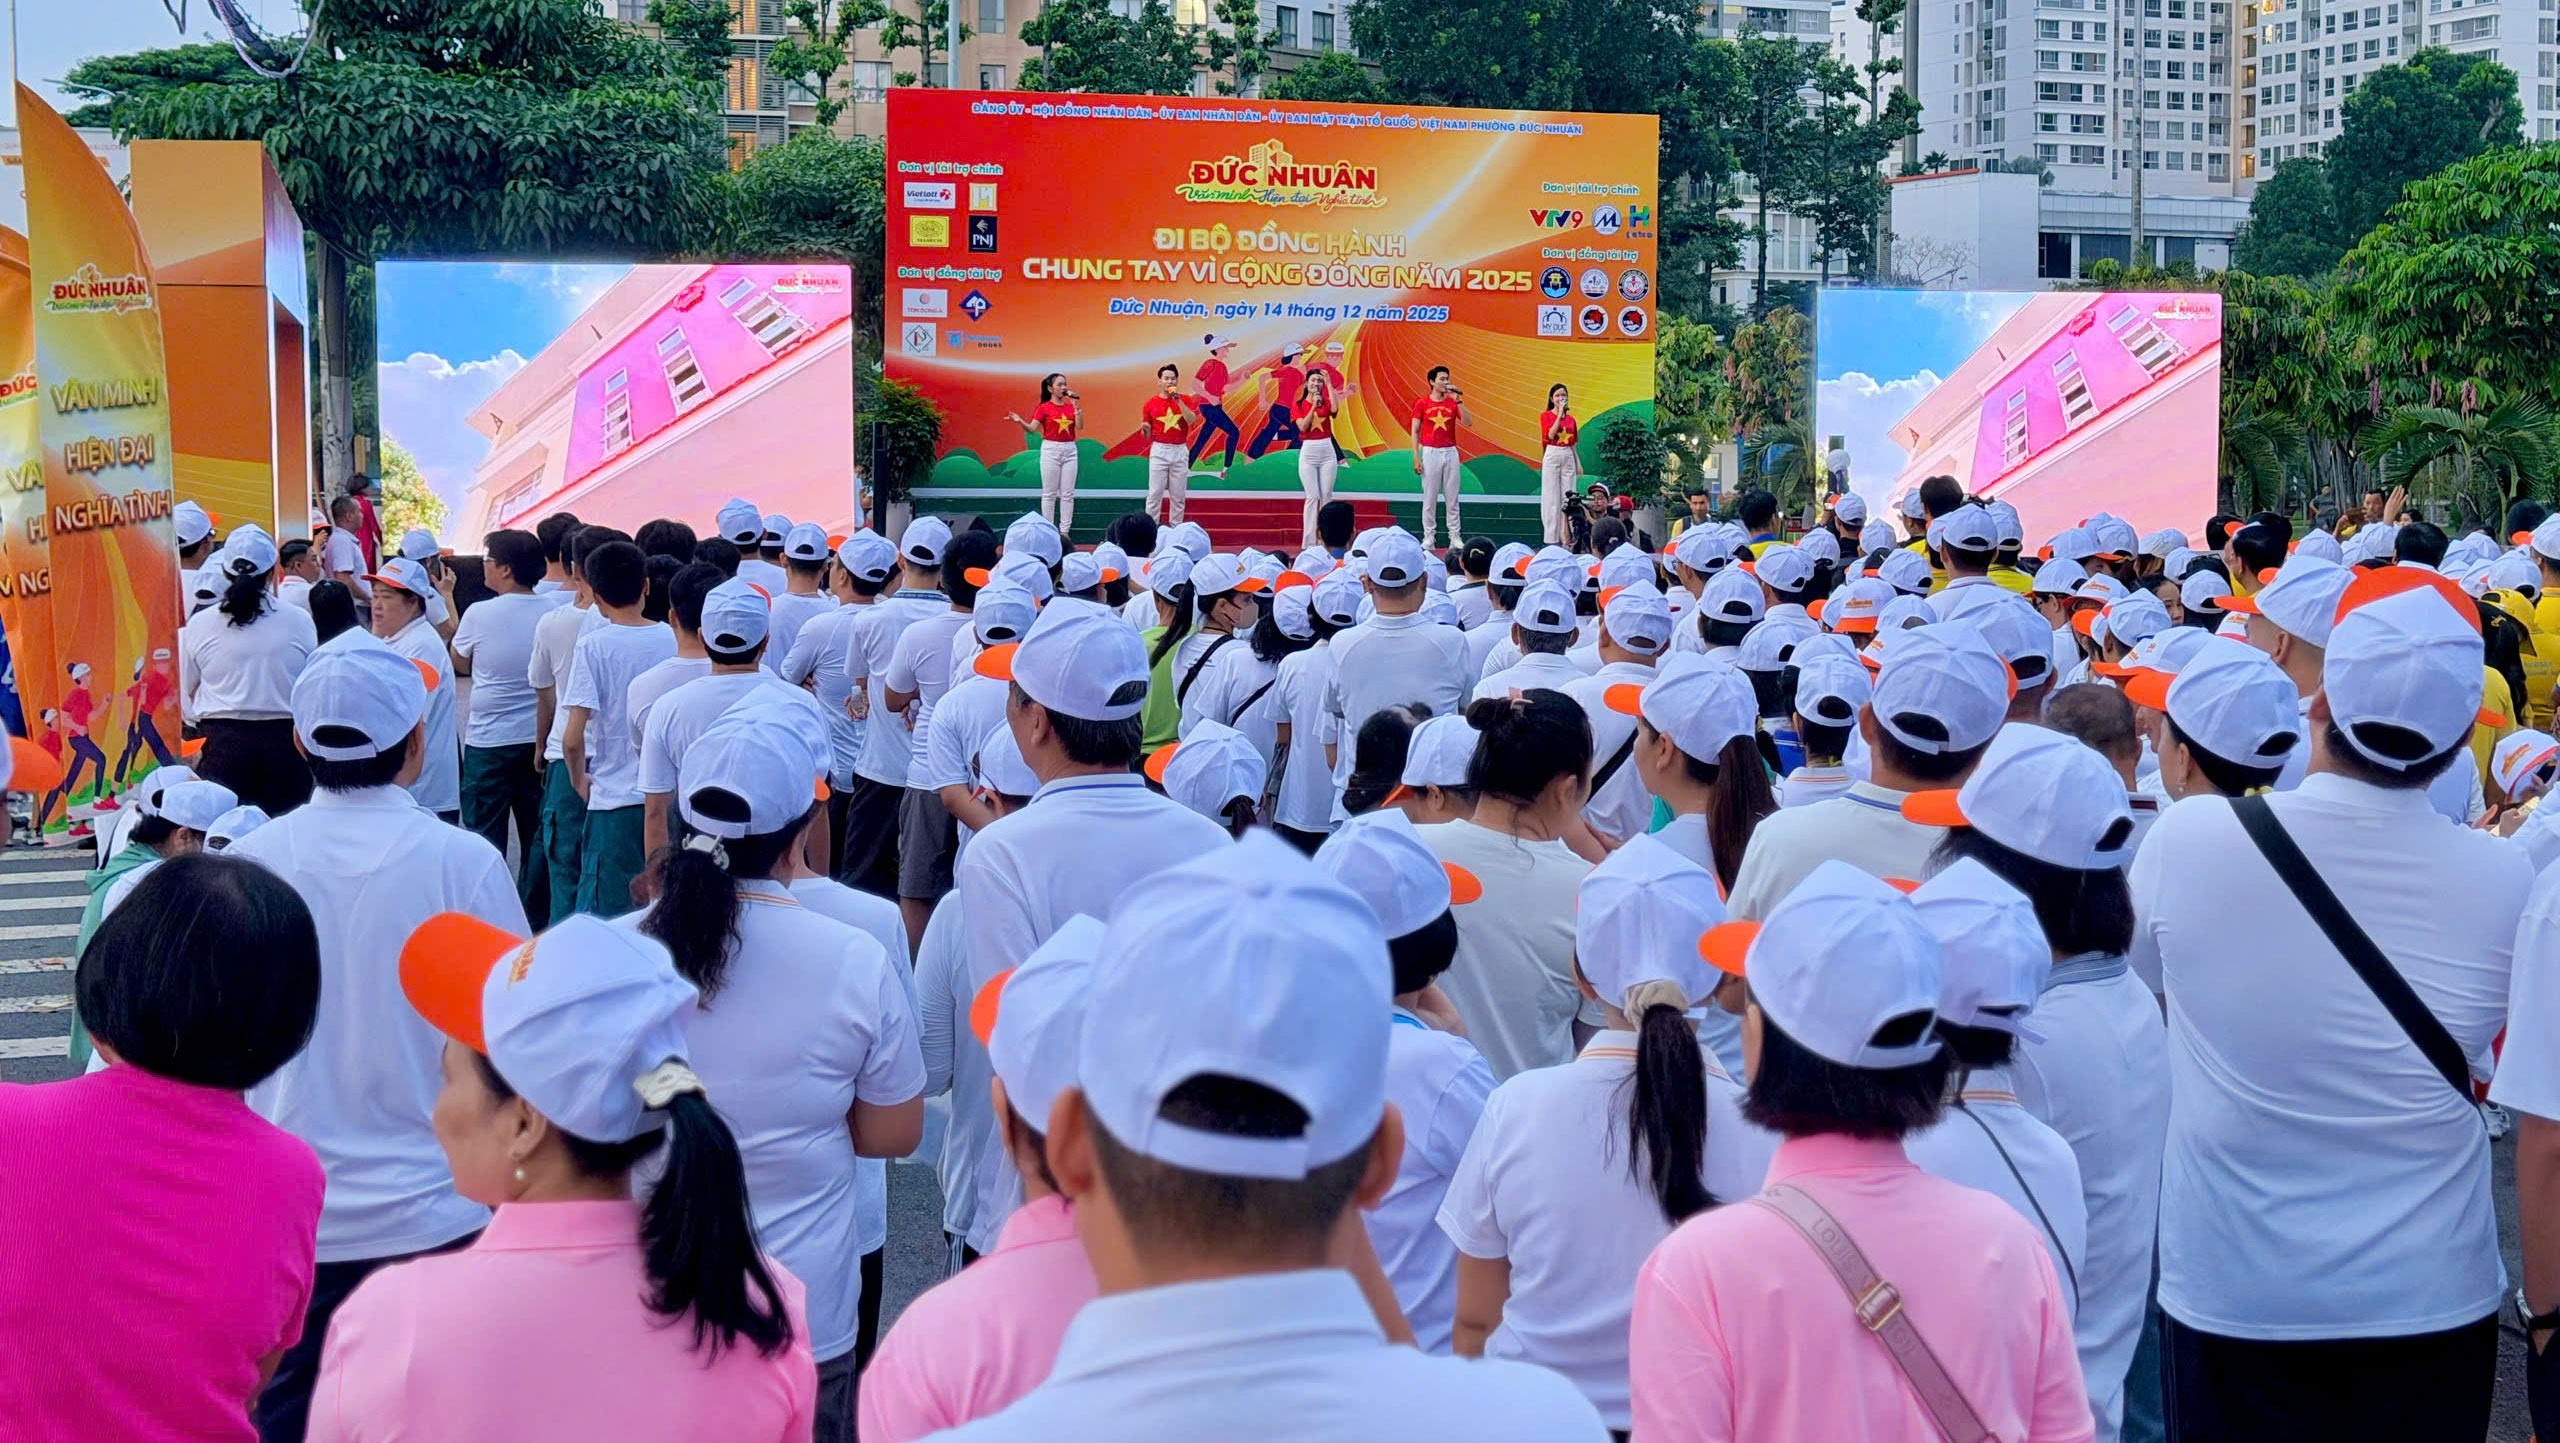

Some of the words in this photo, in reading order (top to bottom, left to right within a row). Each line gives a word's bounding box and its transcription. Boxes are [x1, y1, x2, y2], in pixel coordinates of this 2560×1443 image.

[1032, 103, 1054, 118] HỘI
[1093, 105, 1125, 118] NHÂN
[1127, 105, 1152, 119] DÂN
[1176, 110, 1200, 120] BAN
[1202, 108, 1235, 121] NHÂN
[1236, 109, 1261, 122] DÂN
[1286, 113, 1309, 124] BAN
[1311, 112, 1335, 127] MẶT
[1336, 114, 1364, 129] TRẬN
[1384, 114, 1417, 129] QUỐC
[1419, 117, 1441, 132] VIỆT
[1443, 120, 1467, 131] NAM
[1471, 119, 1516, 132] PHƯỜNG
[1519, 120, 1542, 133] ĐỨC
[1544, 123, 1583, 137] NHUẬN
[898, 161, 922, 172] Đơn
[923, 162, 935, 175] vị
[936, 161, 952, 173] tài
[954, 163, 970, 177] trợ
[971, 163, 1003, 175] chính
[1192, 157, 1258, 186] ĐỨC
[1268, 162, 1375, 194] NHUẬN
[907, 190, 938, 198] Vietlott
[1542, 182, 1563, 193] Đơn
[1566, 184, 1576, 195] vị
[1593, 184, 1608, 196] trợ
[1610, 184, 1640, 195] chính
[1529, 209, 1584, 229] VTV9
[972, 234, 993, 248] PNJ
[1154, 228, 1185, 250] ĐI
[1191, 224, 1231, 254] BỘ
[1236, 221, 1320, 253] ĐỒNG
[1325, 229, 1406, 256] HÀNH
[1542, 247, 1563, 258] Đơn
[1566, 249, 1576, 261] vị
[1607, 250, 1621, 260] tài
[1623, 250, 1638, 263] trợ
[898, 267, 922, 278] Đơn
[923, 267, 935, 281] vị
[936, 265, 966, 281] đồng
[968, 267, 984, 278] tài
[985, 268, 1002, 282] trợ
[1023, 258, 1122, 281] CHUNG
[1128, 260, 1184, 281] TAY
[1189, 256, 1217, 282] VÌ
[1222, 256, 1302, 287] CỘNG
[1307, 256, 1389, 287] ĐỒNG
[1394, 263, 1460, 289] NĂM
[1467, 270, 1532, 291] 2025
[53, 279, 86, 299] ĐỨC
[88, 277, 147, 300] NHUẬN
[1109, 299, 1144, 315] Đức
[1149, 300, 1208, 318] Nhuận,
[1214, 302, 1257, 319] ngày
[1263, 303, 1282, 316] 14
[1287, 304, 1336, 320] tháng
[1343, 305, 1361, 318] 12
[1365, 306, 1403, 320] năm
[1406, 307, 1448, 320] 2025
[0, 375, 37, 398] ĐỨC
[102, 378, 158, 407] MINH
[65, 437, 115, 473] HIỆN
[118, 436, 154, 469] ĐẠI
[55, 495, 125, 531] NGHĨA
[125, 490, 172, 520] TÌNH
